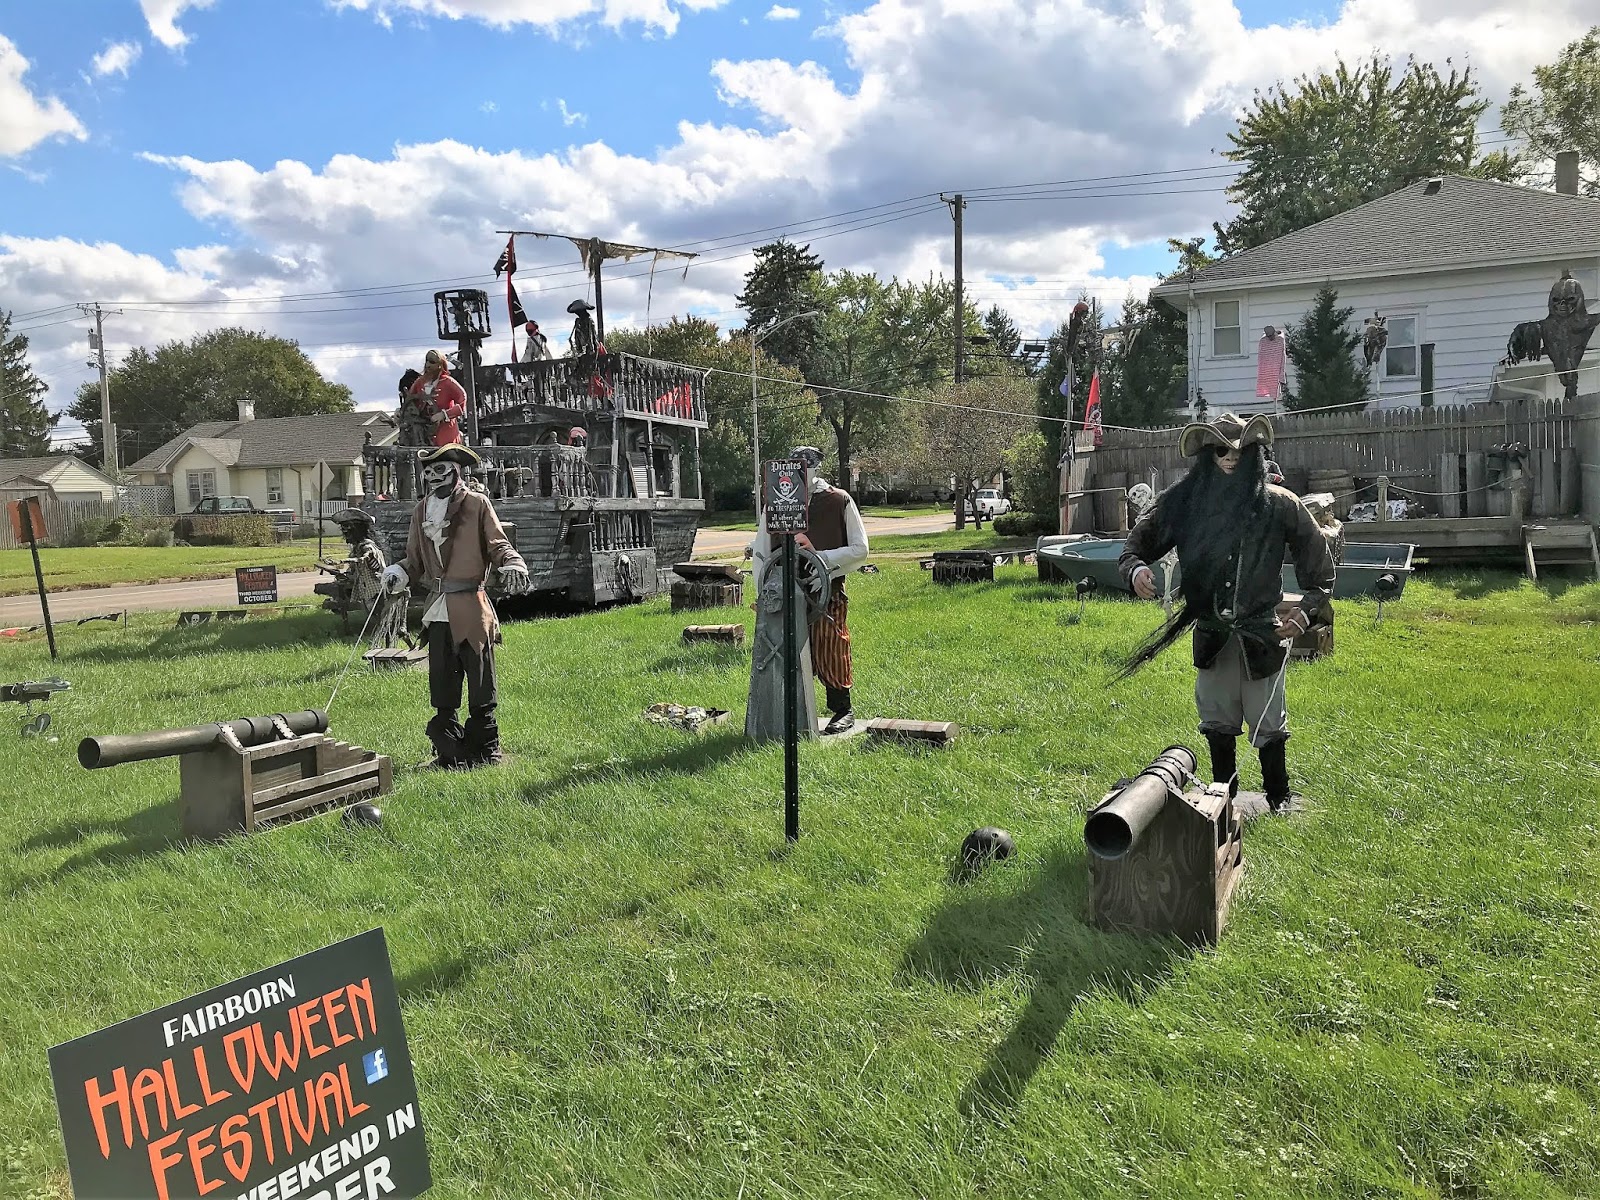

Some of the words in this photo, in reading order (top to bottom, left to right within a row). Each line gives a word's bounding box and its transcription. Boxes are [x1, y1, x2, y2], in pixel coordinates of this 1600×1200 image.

[771, 461, 801, 472] Pirates
[162, 974, 296, 1048] FAIRBORN
[84, 977, 378, 1160] HALLOWEEN
[147, 1062, 371, 1200] FESTIVAL
[386, 1102, 416, 1141] IN
